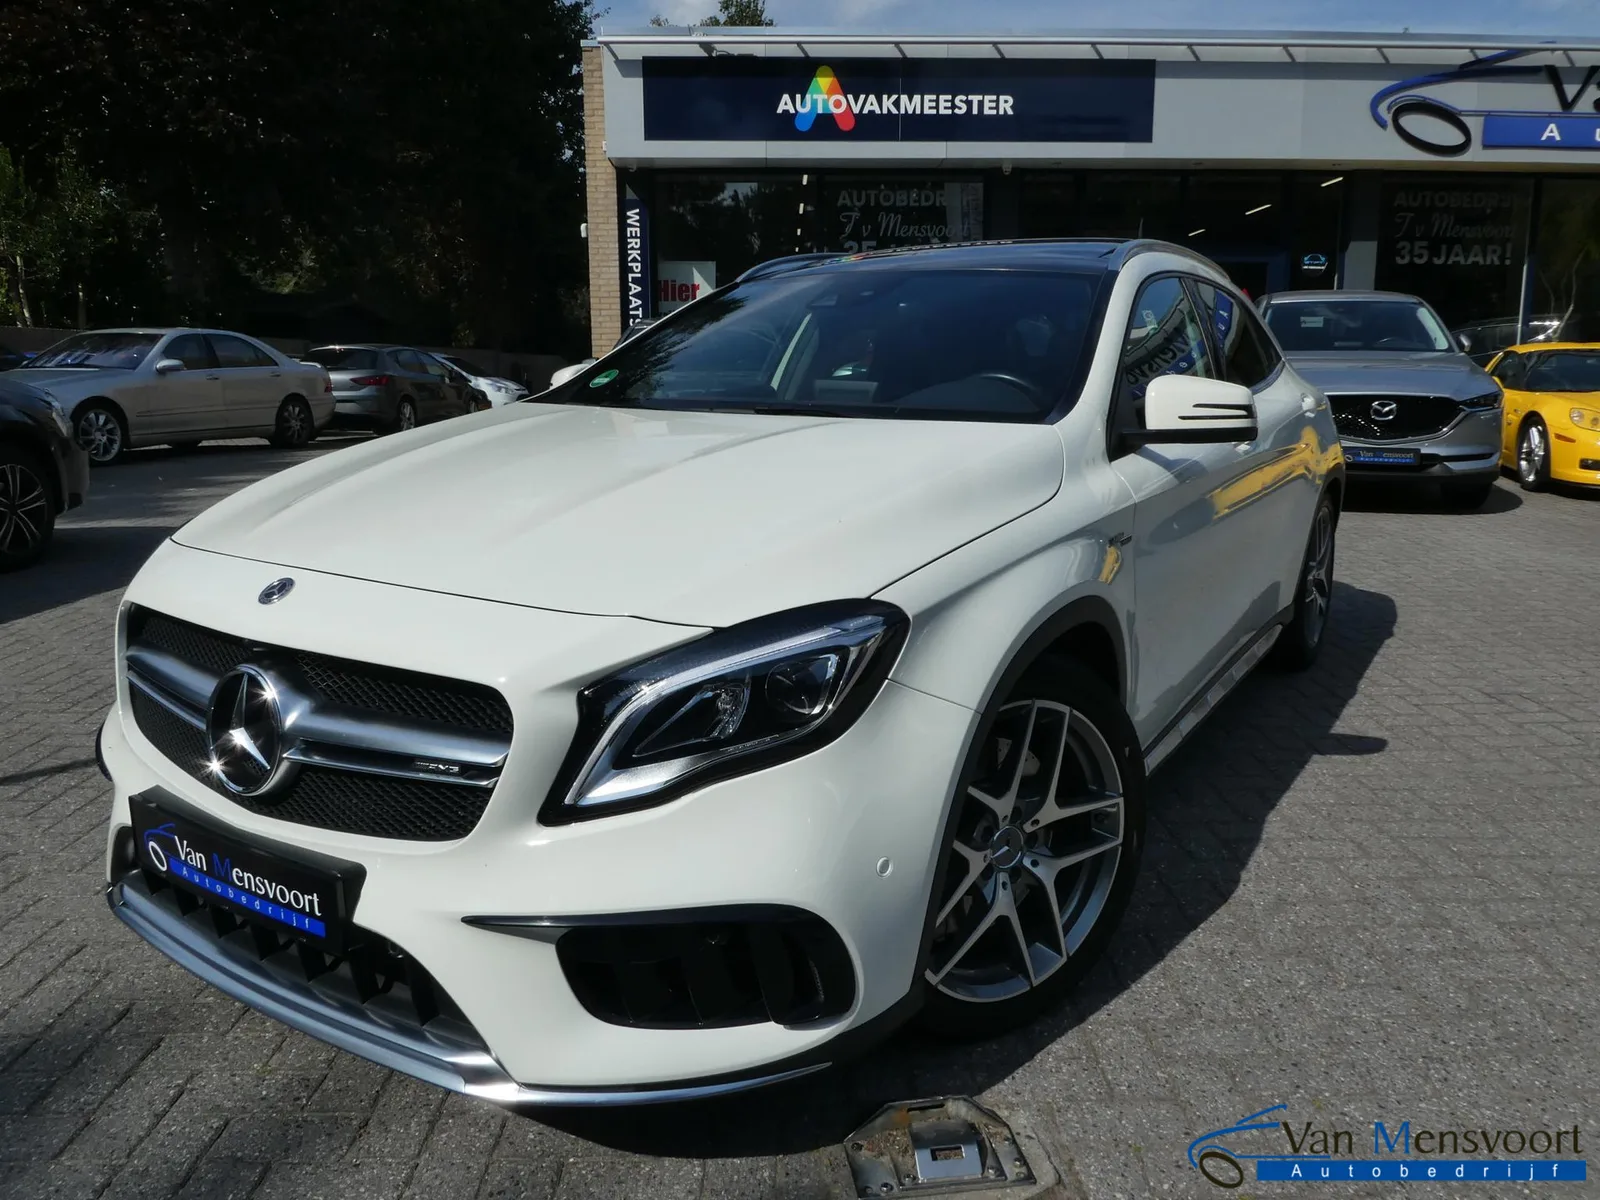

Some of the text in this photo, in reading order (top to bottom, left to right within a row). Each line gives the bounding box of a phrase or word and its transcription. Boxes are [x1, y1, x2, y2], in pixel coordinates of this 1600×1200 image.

[776, 93, 1014, 115] AUTOVAKMEESTER
[837, 188, 971, 207] AUTOBEDR
[1395, 240, 1513, 266] 35 JAAR!
[659, 279, 700, 302] Hier
[174, 835, 322, 917] Van Mensvoort
[181, 865, 310, 929] Autobedrijf
